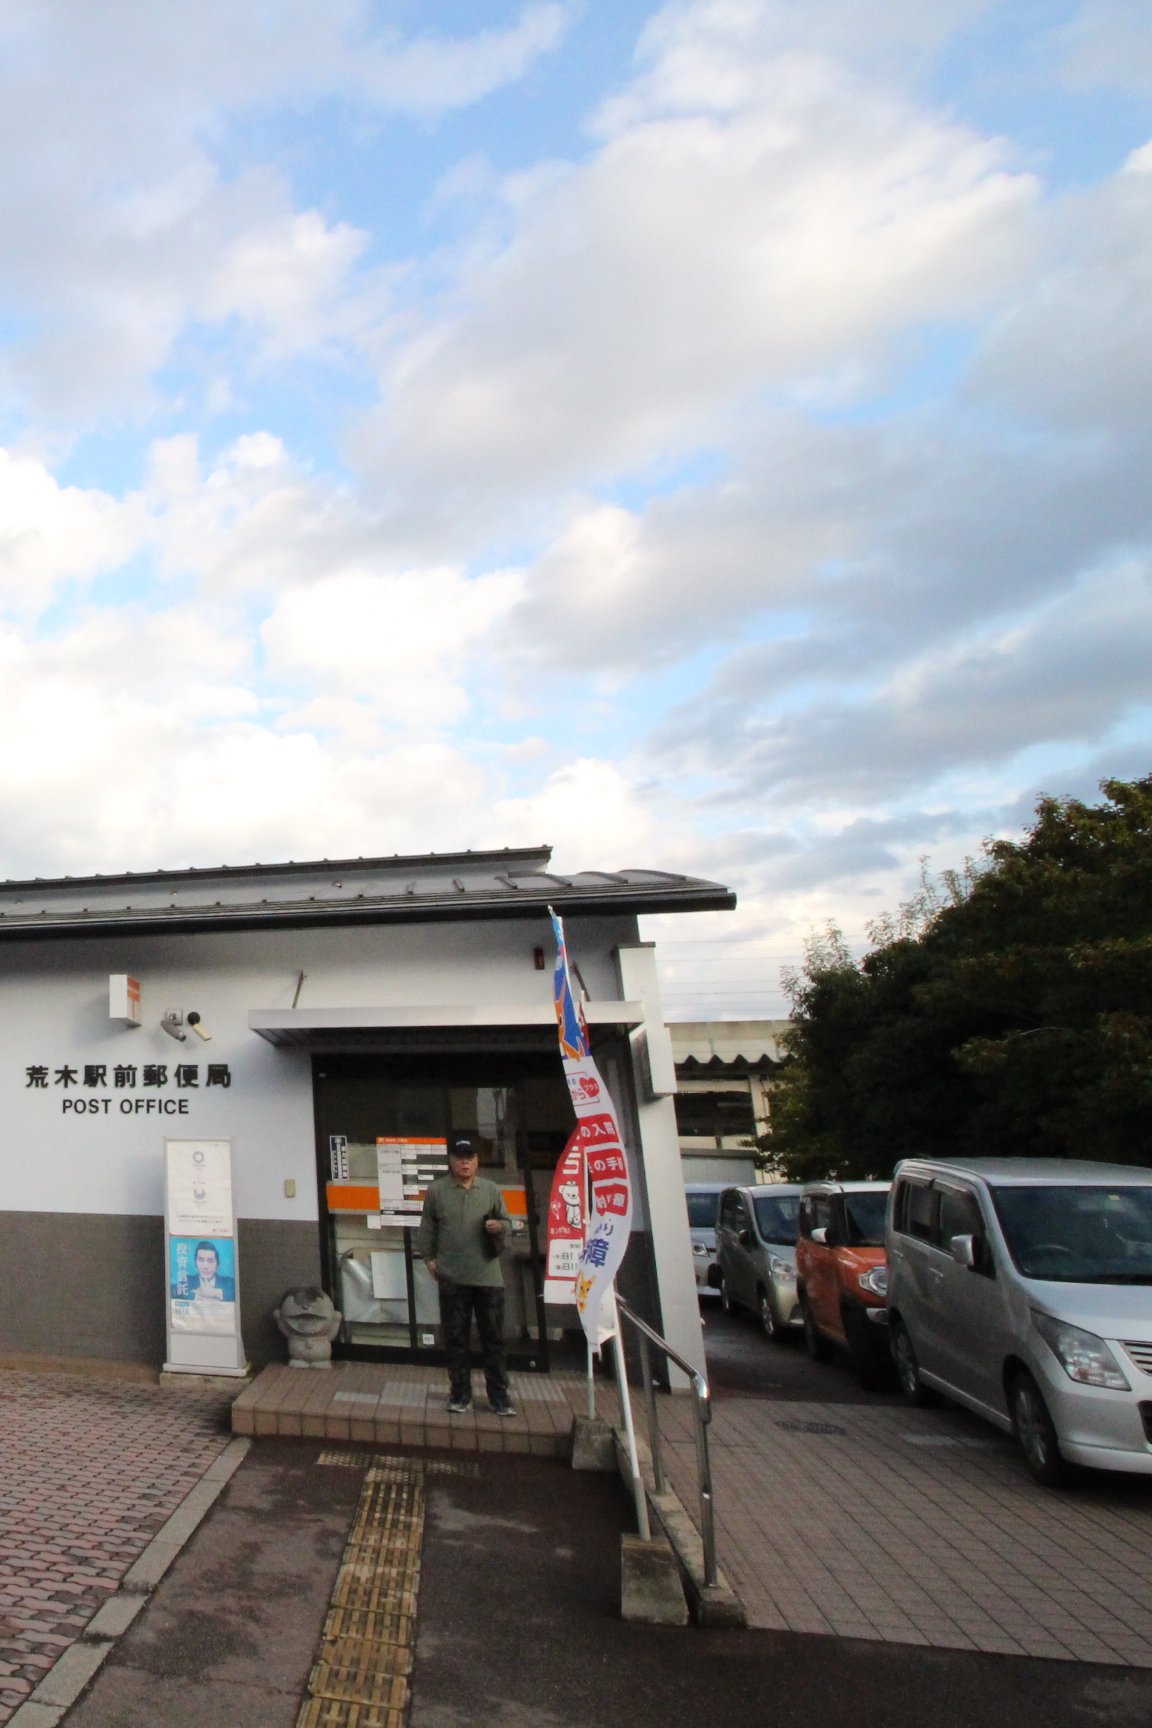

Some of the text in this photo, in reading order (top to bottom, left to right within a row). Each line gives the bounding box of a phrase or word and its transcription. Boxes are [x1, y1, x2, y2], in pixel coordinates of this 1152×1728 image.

[26, 1064, 232, 1089] 荒木駅前郵便局
[61, 1098, 190, 1115] POST OFFICE
